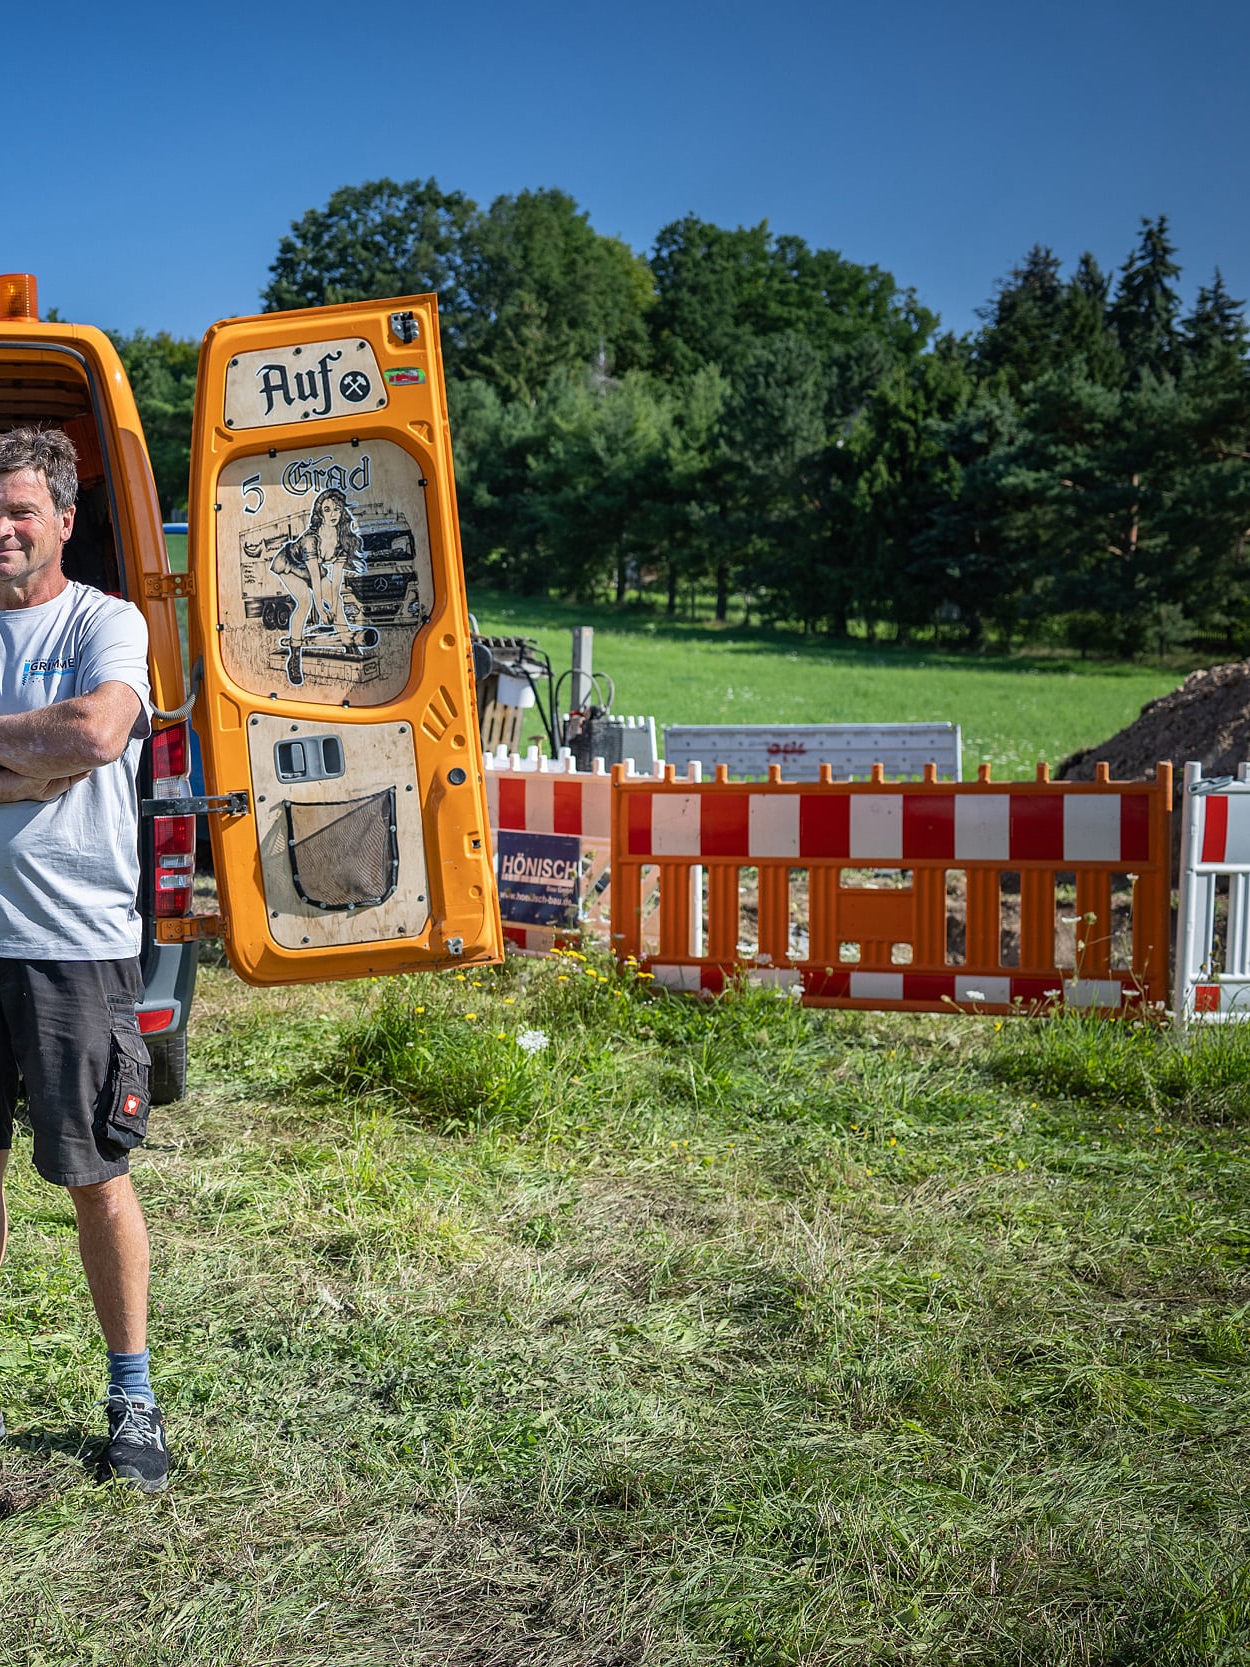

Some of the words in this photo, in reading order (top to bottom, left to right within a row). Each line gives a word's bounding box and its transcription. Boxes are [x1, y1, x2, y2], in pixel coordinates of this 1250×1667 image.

[256, 350, 343, 416] Auf
[242, 475, 264, 514] 5
[281, 455, 371, 496] Grad
[30, 658, 75, 671] GRIMME
[502, 852, 577, 880] HÖNISCH
